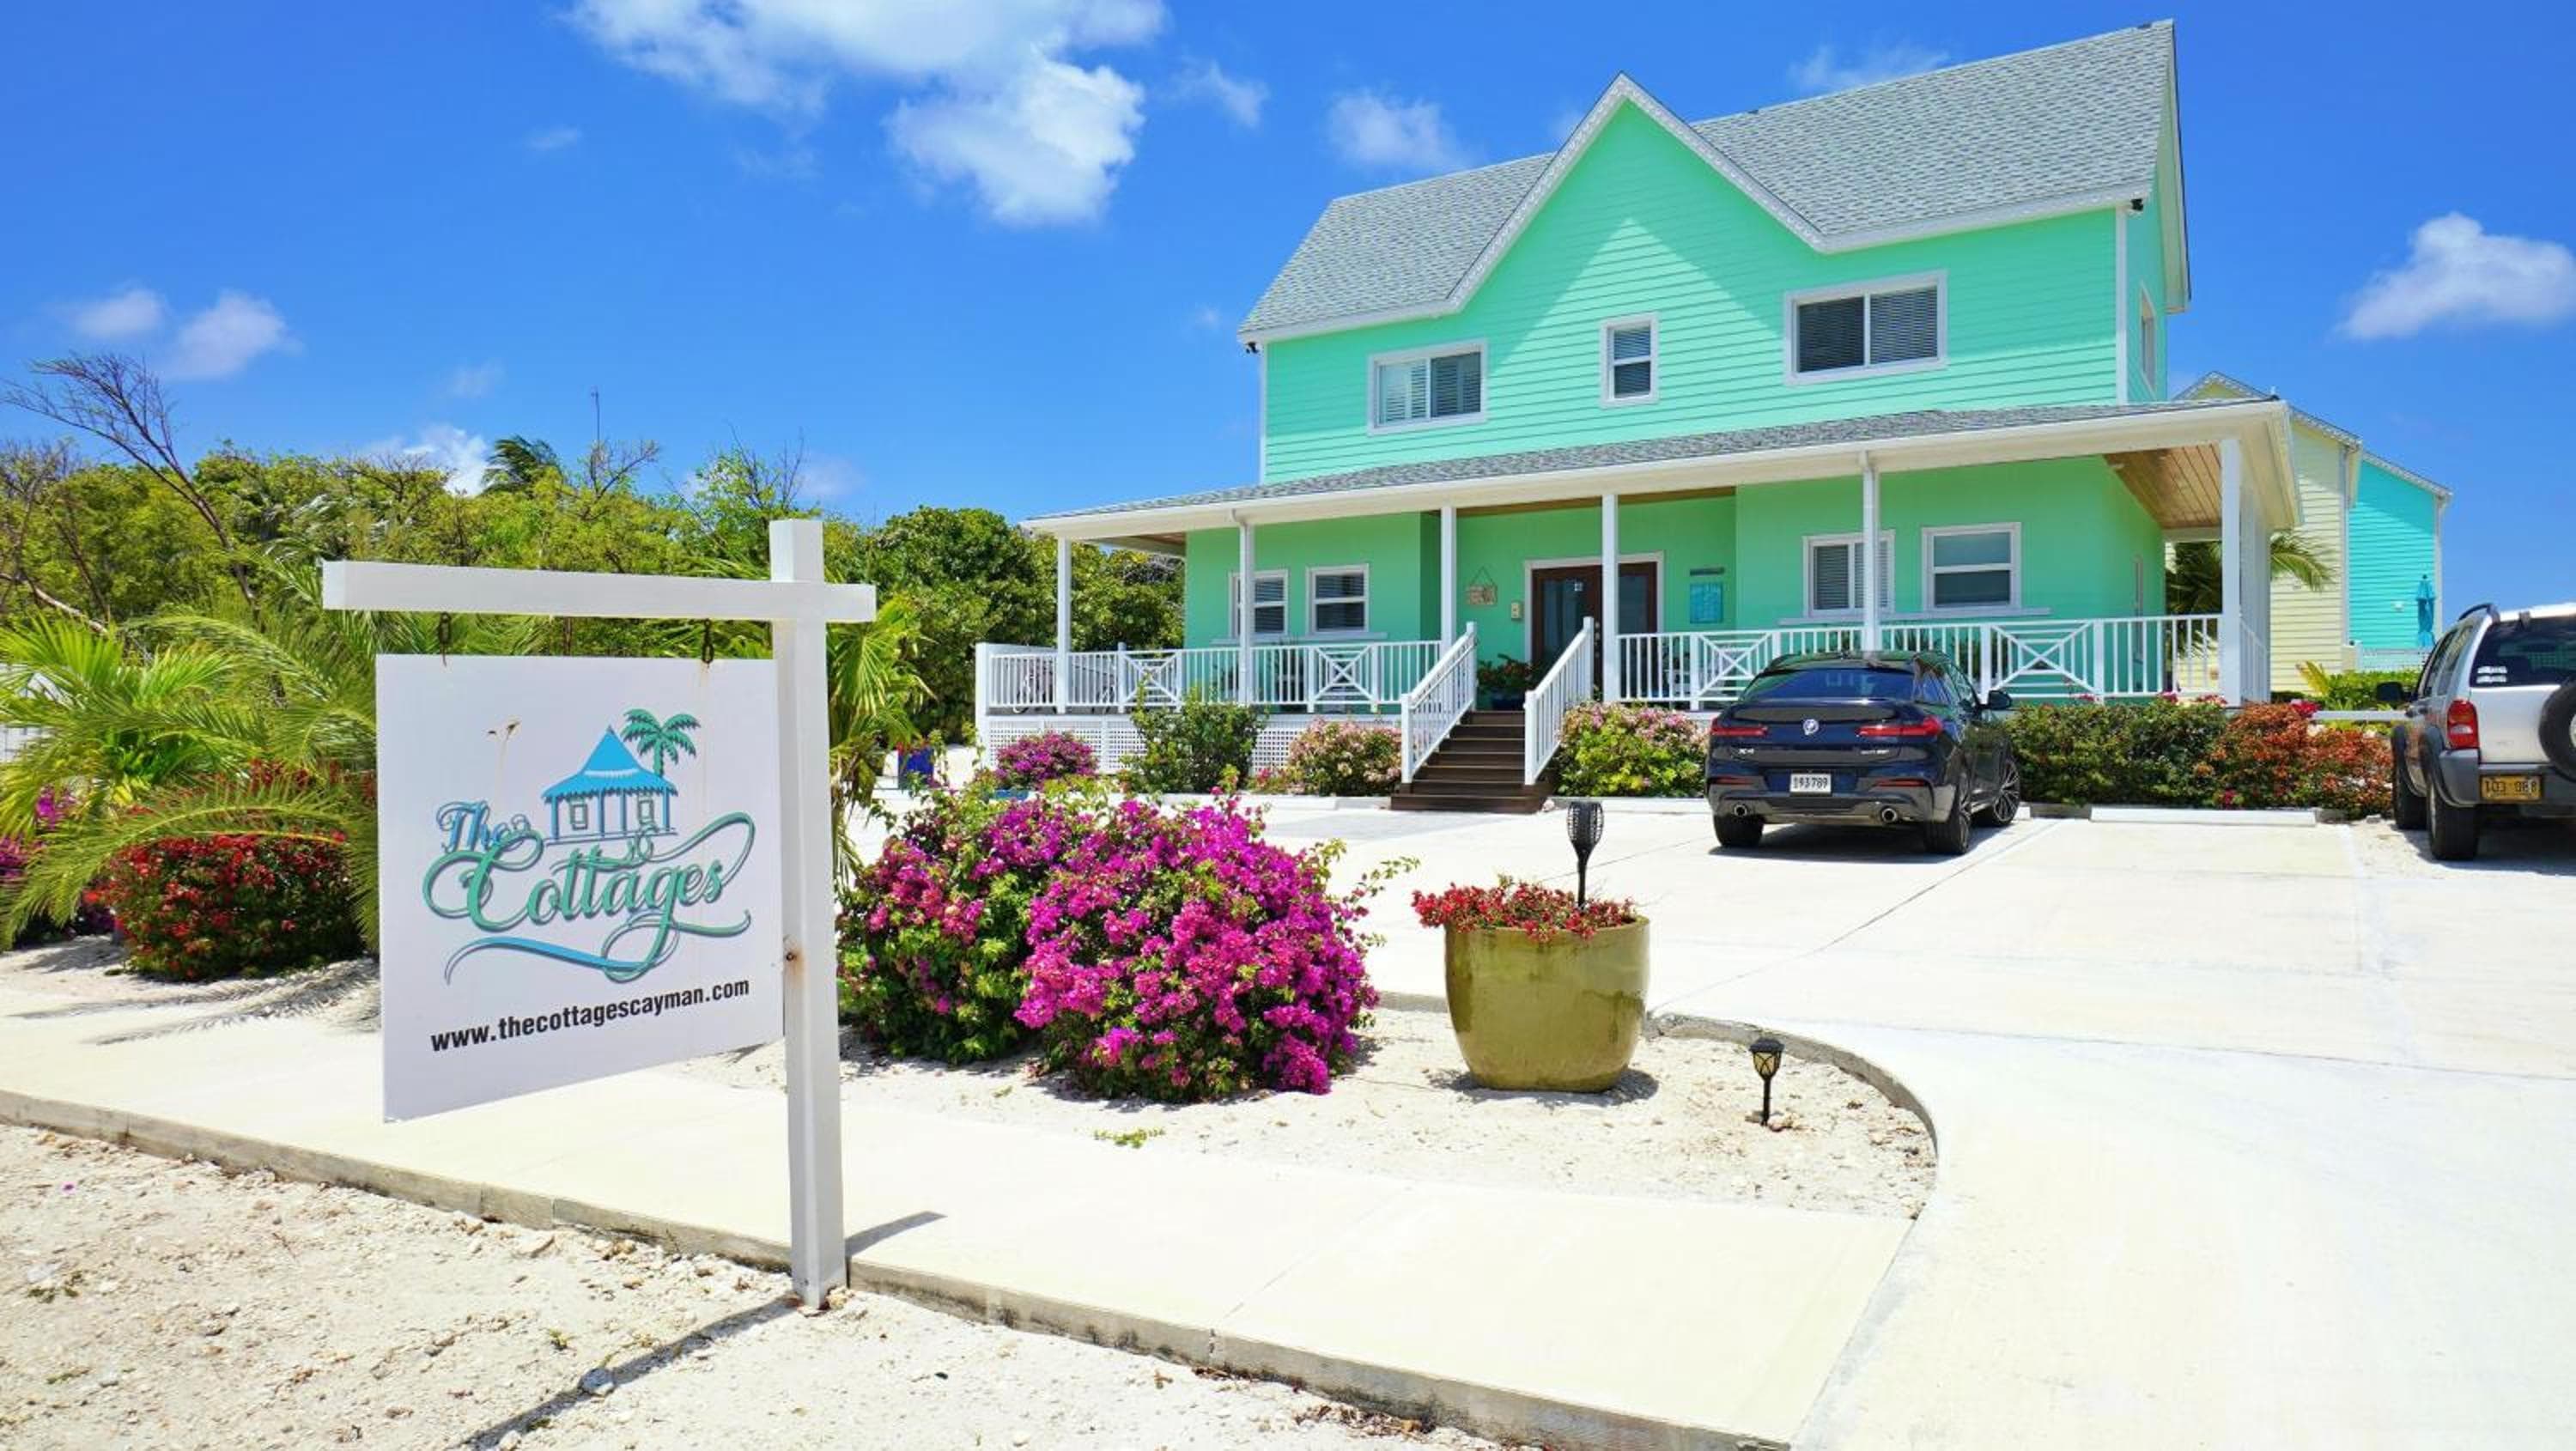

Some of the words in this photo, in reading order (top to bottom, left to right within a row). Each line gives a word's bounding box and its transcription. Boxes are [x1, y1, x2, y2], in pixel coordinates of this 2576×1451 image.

[436, 800, 531, 855] The
[422, 808, 756, 984] Cottages
[431, 980, 750, 1052] www.thecottagescayman.com
